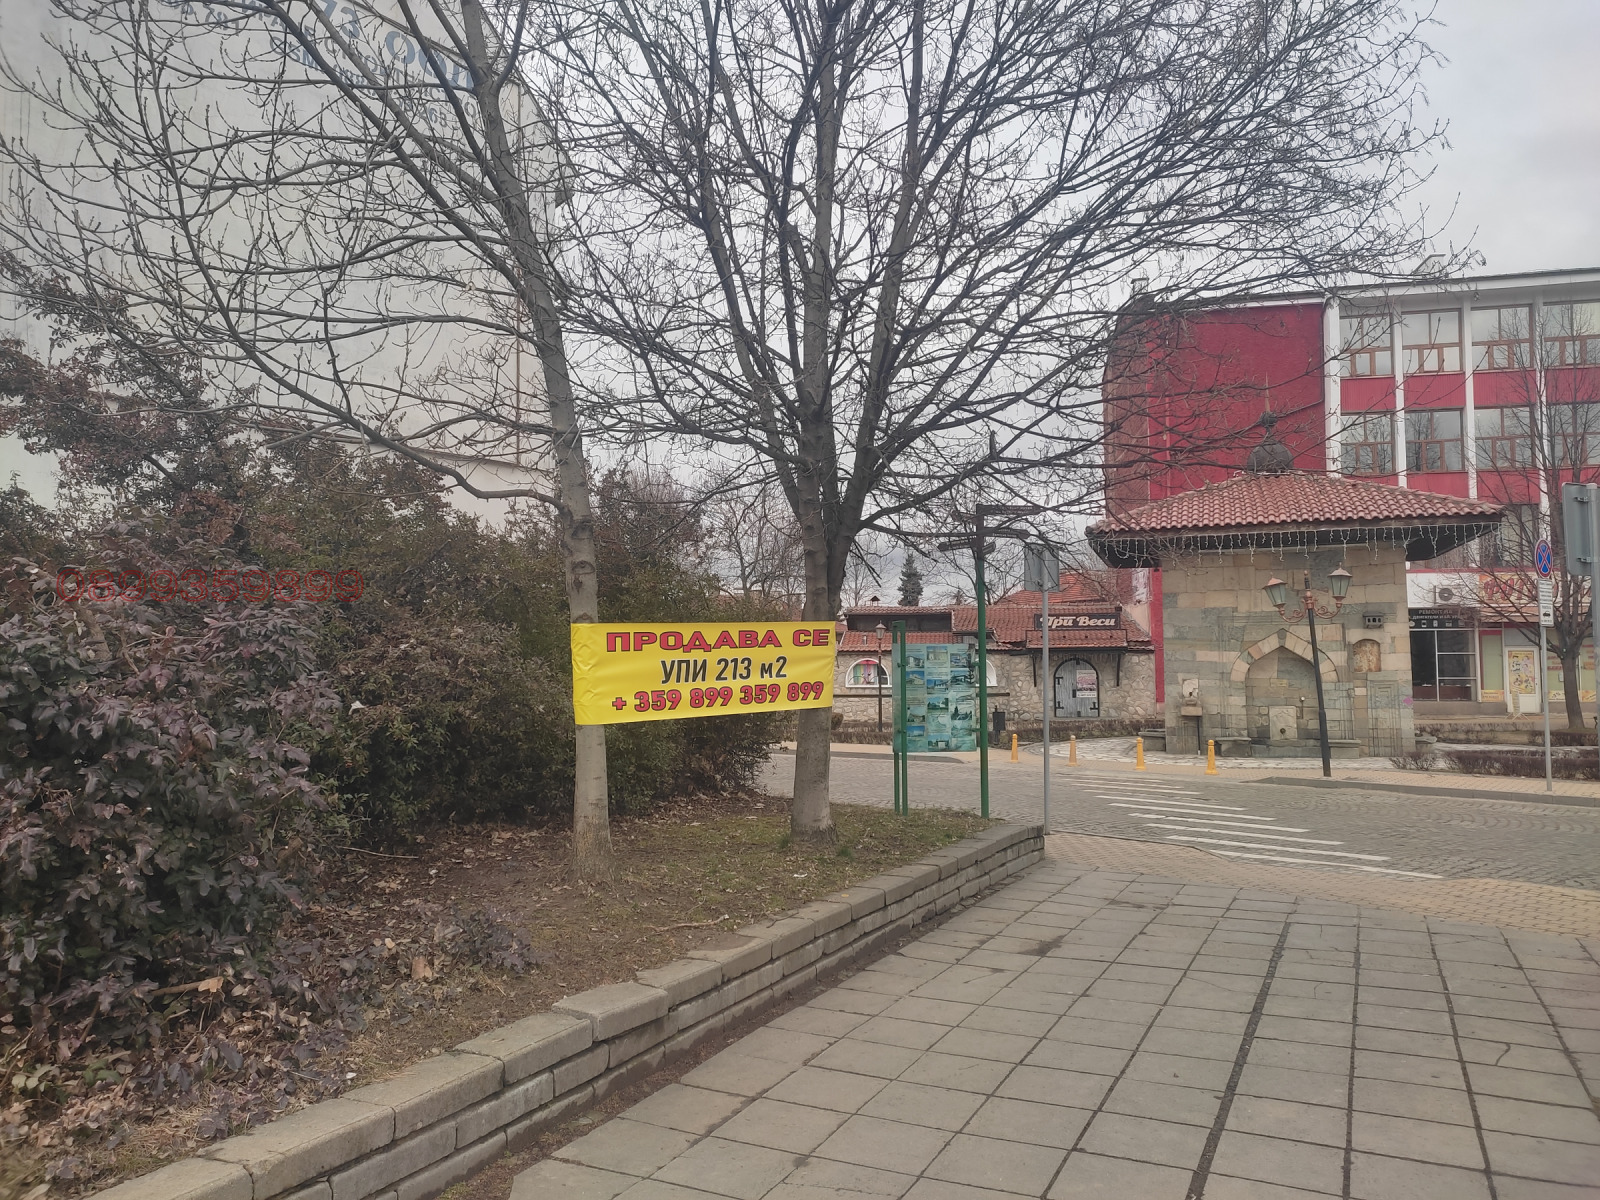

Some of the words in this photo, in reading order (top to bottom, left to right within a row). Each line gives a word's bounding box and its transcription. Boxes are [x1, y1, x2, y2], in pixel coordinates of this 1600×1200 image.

[1077, 616, 1116, 626] Веси
[606, 630, 782, 653] ПРОДАВА
[793, 629, 831, 647] СЕ
[660, 657, 708, 685] УПИ
[715, 657, 752, 682] 213
[760, 656, 787, 679] м2
[634, 689, 682, 712] 359
[690, 686, 733, 708] 899
[739, 683, 781, 705] 359
[787, 681, 825, 702] 899
